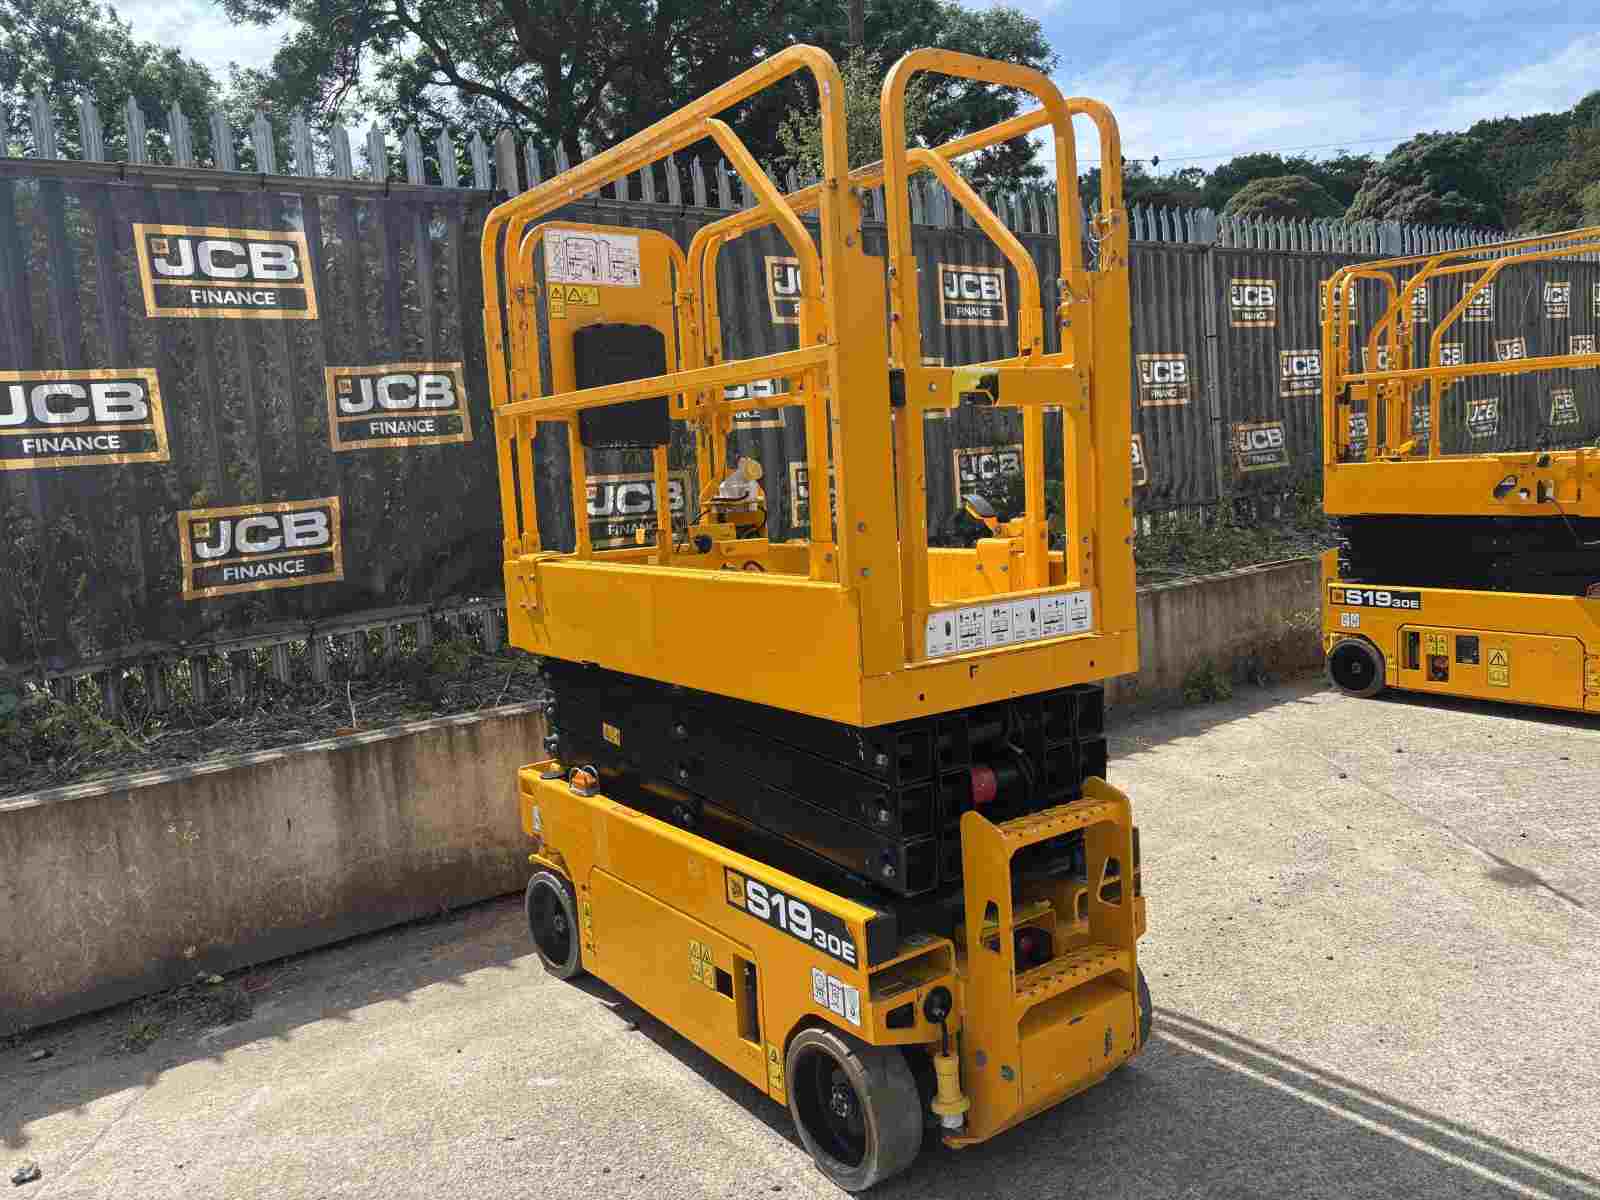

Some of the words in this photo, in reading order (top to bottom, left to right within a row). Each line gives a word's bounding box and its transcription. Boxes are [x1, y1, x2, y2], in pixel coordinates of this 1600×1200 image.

[153, 239, 299, 279] JCB
[190, 288, 277, 305] FINANCE
[944, 272, 1001, 300] JCB
[1231, 286, 1274, 306] JCB
[1143, 360, 1186, 384] JCB
[0, 381, 150, 427] JCB
[336, 373, 457, 415] JCB
[369, 418, 436, 435] FINANCE
[22, 433, 121, 454] FINANCE
[194, 510, 330, 558] JCB
[222, 559, 305, 581] FINANCE
